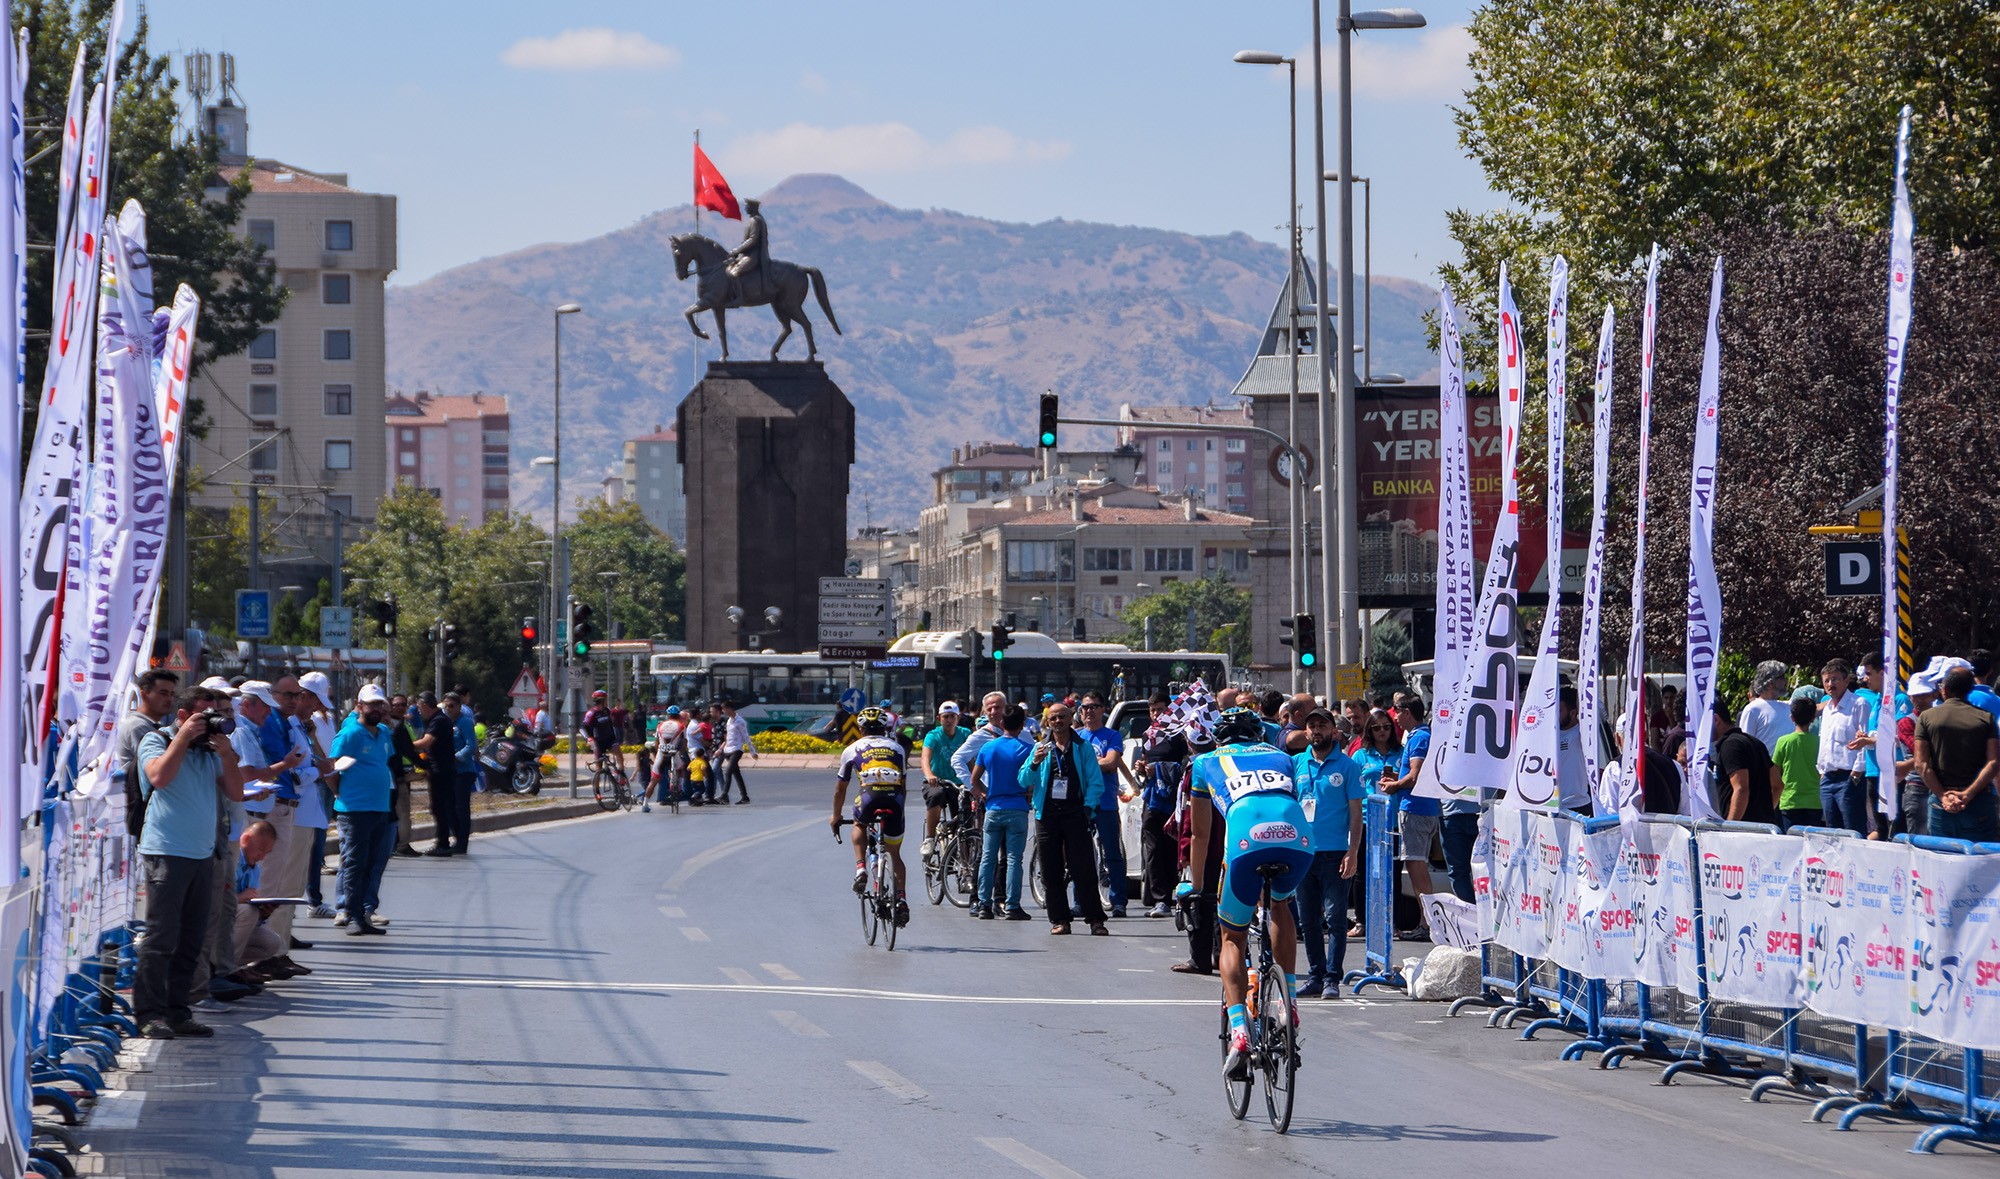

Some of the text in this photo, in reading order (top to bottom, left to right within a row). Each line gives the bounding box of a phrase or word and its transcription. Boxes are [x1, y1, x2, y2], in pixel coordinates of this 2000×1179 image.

[1363, 408, 1439, 431] “YER
[1373, 438, 1441, 462] YER
[1373, 479, 1435, 496] BANKA
[1384, 572, 1438, 584] 444 3 56
[1839, 552, 1871, 586] D
[822, 629, 854, 638] Otogar
[831, 648, 867, 657] Erciyes
[1253, 830, 1297, 840] MOTORS
[1767, 930, 1802, 956] SPOR
[1866, 943, 1905, 971] SPOR
